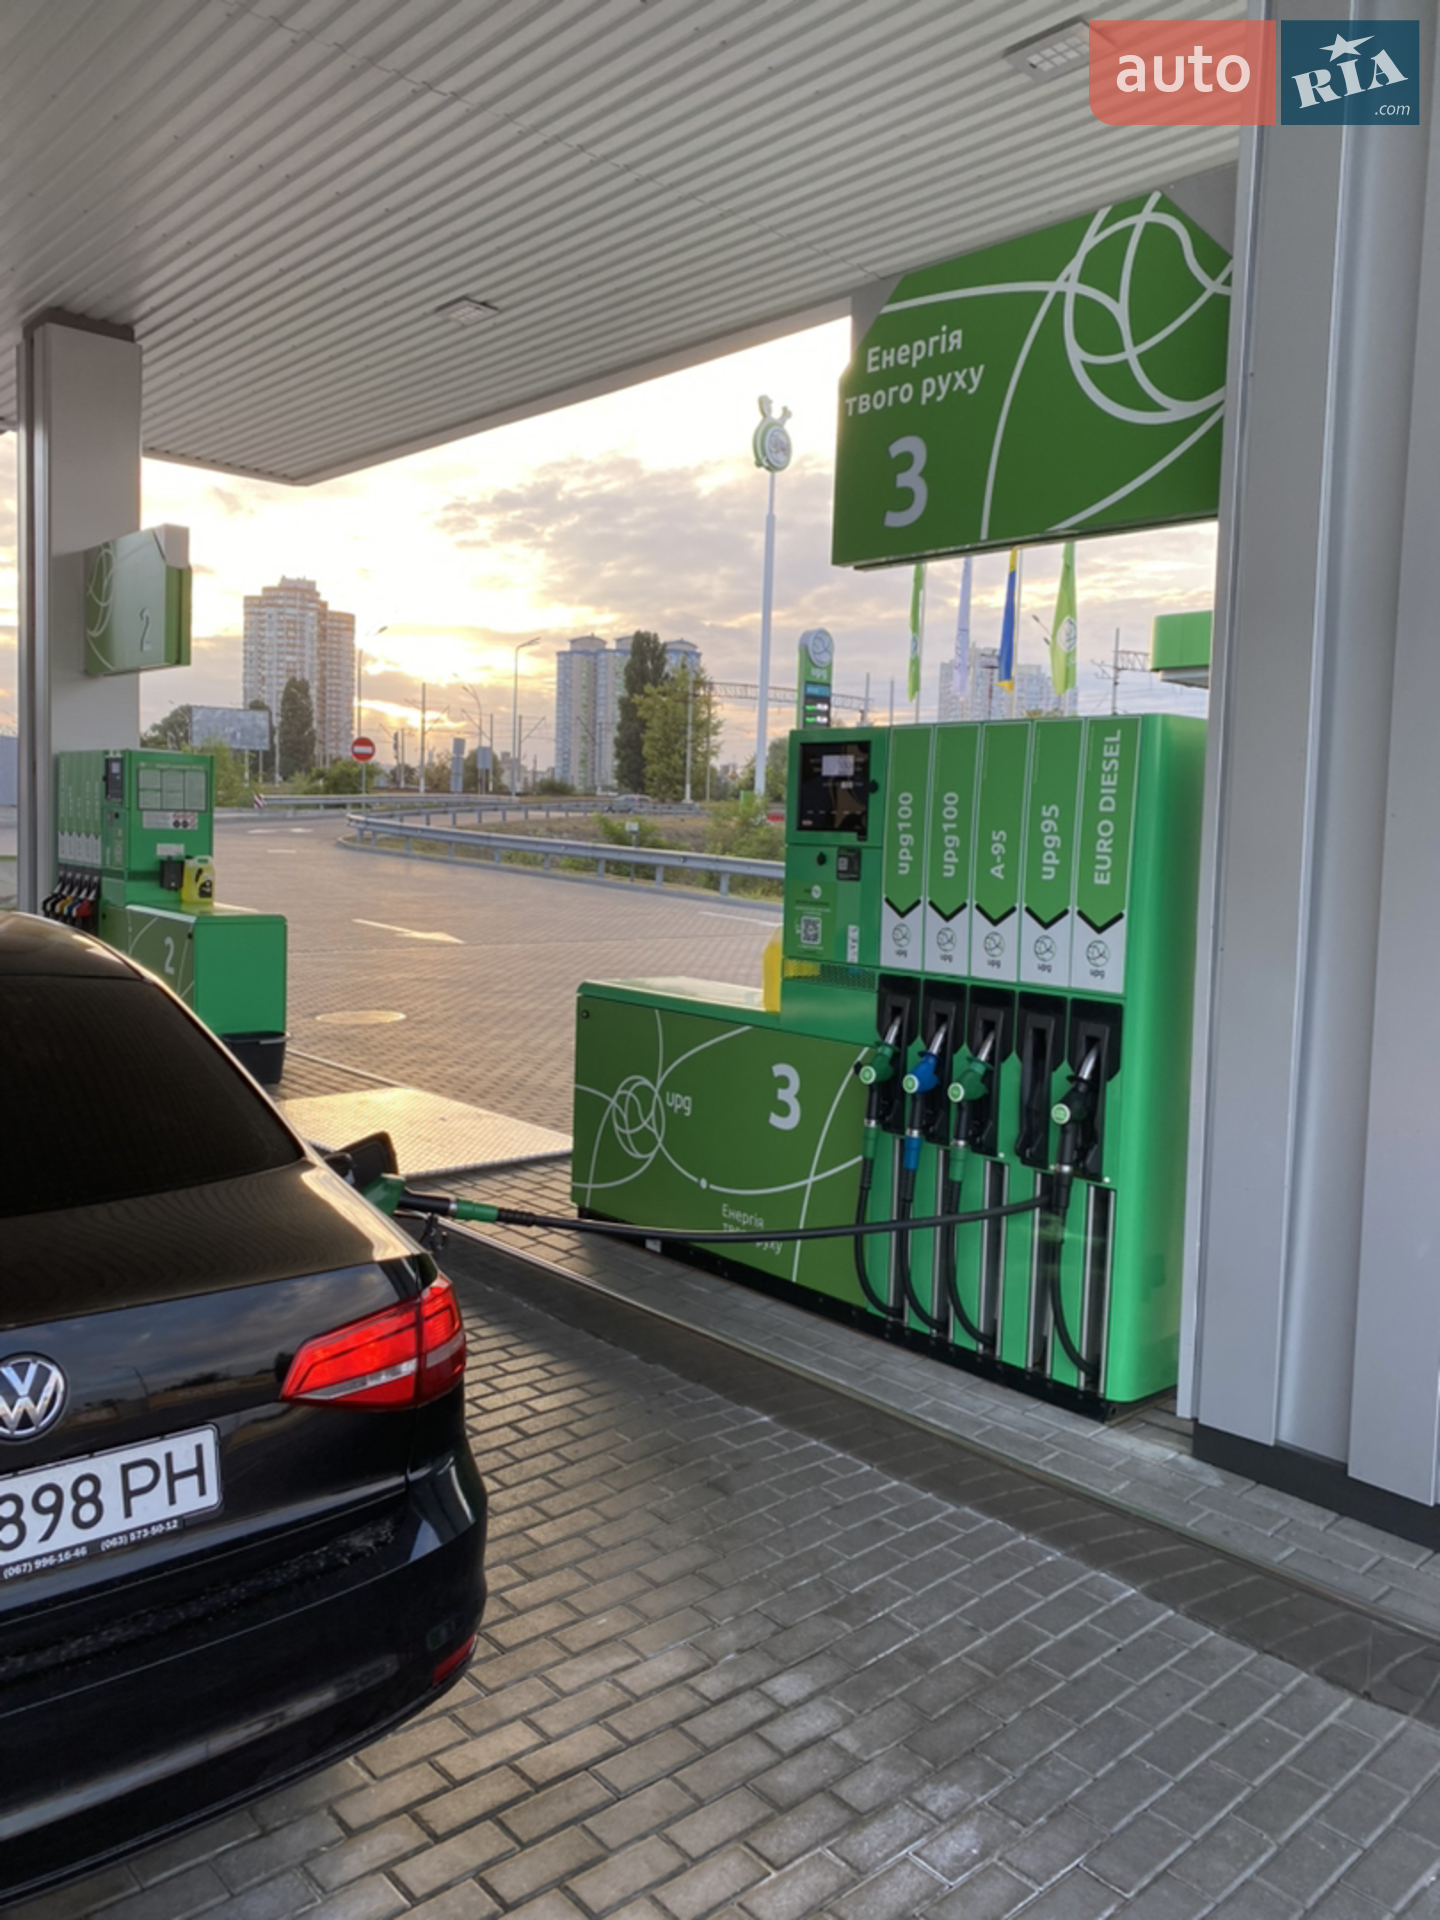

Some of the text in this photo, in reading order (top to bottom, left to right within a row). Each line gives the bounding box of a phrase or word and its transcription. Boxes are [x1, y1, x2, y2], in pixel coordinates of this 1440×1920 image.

[866, 325, 964, 374] Енергія
[845, 363, 986, 417] твого руху
[883, 434, 929, 528] 3
[897, 791, 915, 876] upg100
[941, 791, 961, 879] upg100
[1040, 804, 1062, 882] upg95
[1093, 728, 1122, 886] EURO DIESEL
[164, 936, 175, 975] 2
[665, 1090, 693, 1117] upg
[768, 1062, 802, 1131] 3
[721, 1203, 765, 1230] Енергія
[0, 1472, 104, 1552] 898
